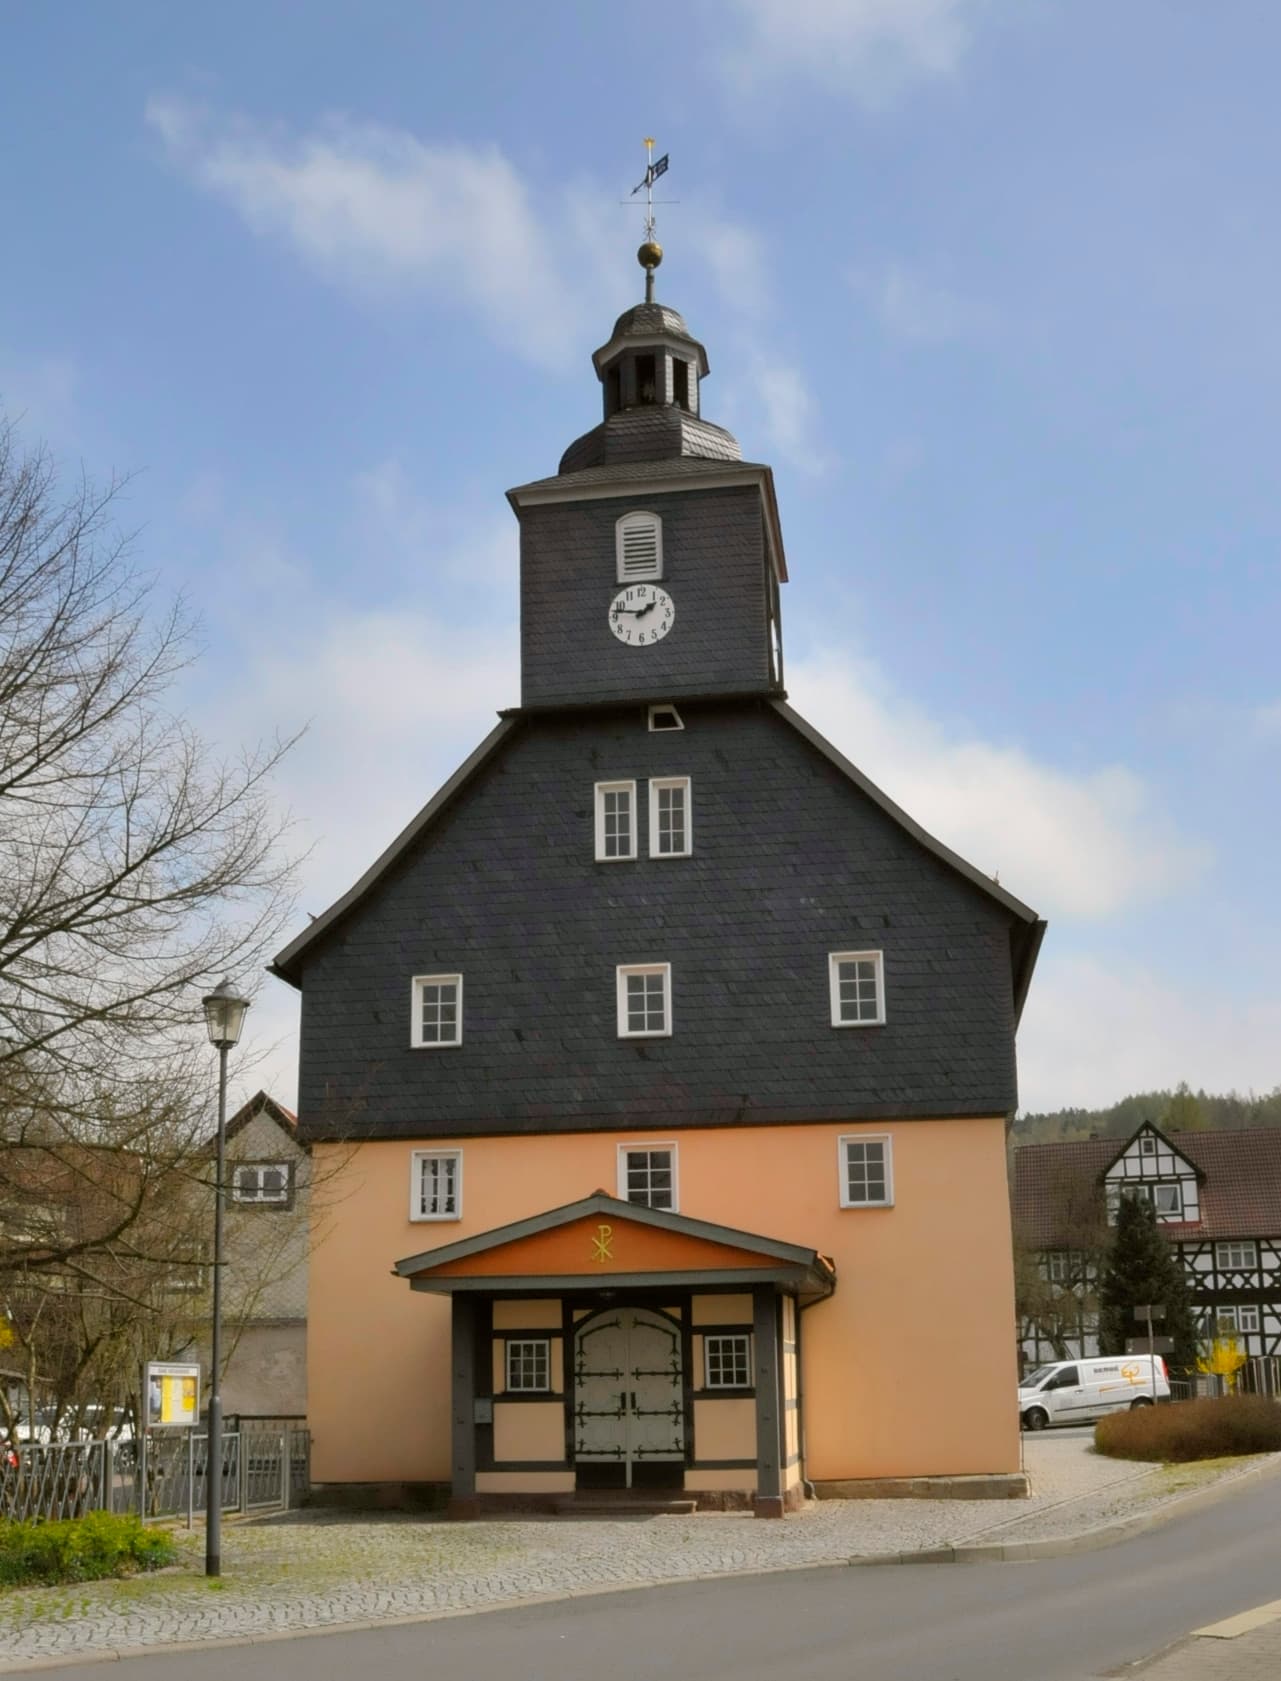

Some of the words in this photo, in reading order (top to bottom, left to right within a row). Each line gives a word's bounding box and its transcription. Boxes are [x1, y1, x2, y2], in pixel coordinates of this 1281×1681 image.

[626, 591, 633, 601] 11
[637, 587, 646, 597] 12
[652, 591, 656, 601] 1
[660, 596, 666, 607] 2
[612, 612, 618, 623] 9
[665, 607, 671, 618] 3
[617, 624, 623, 634] 8
[661, 621, 667, 632] 4
[626, 630, 632, 640] 7
[639, 633, 645, 643] 6
[651, 629, 657, 639] 5
